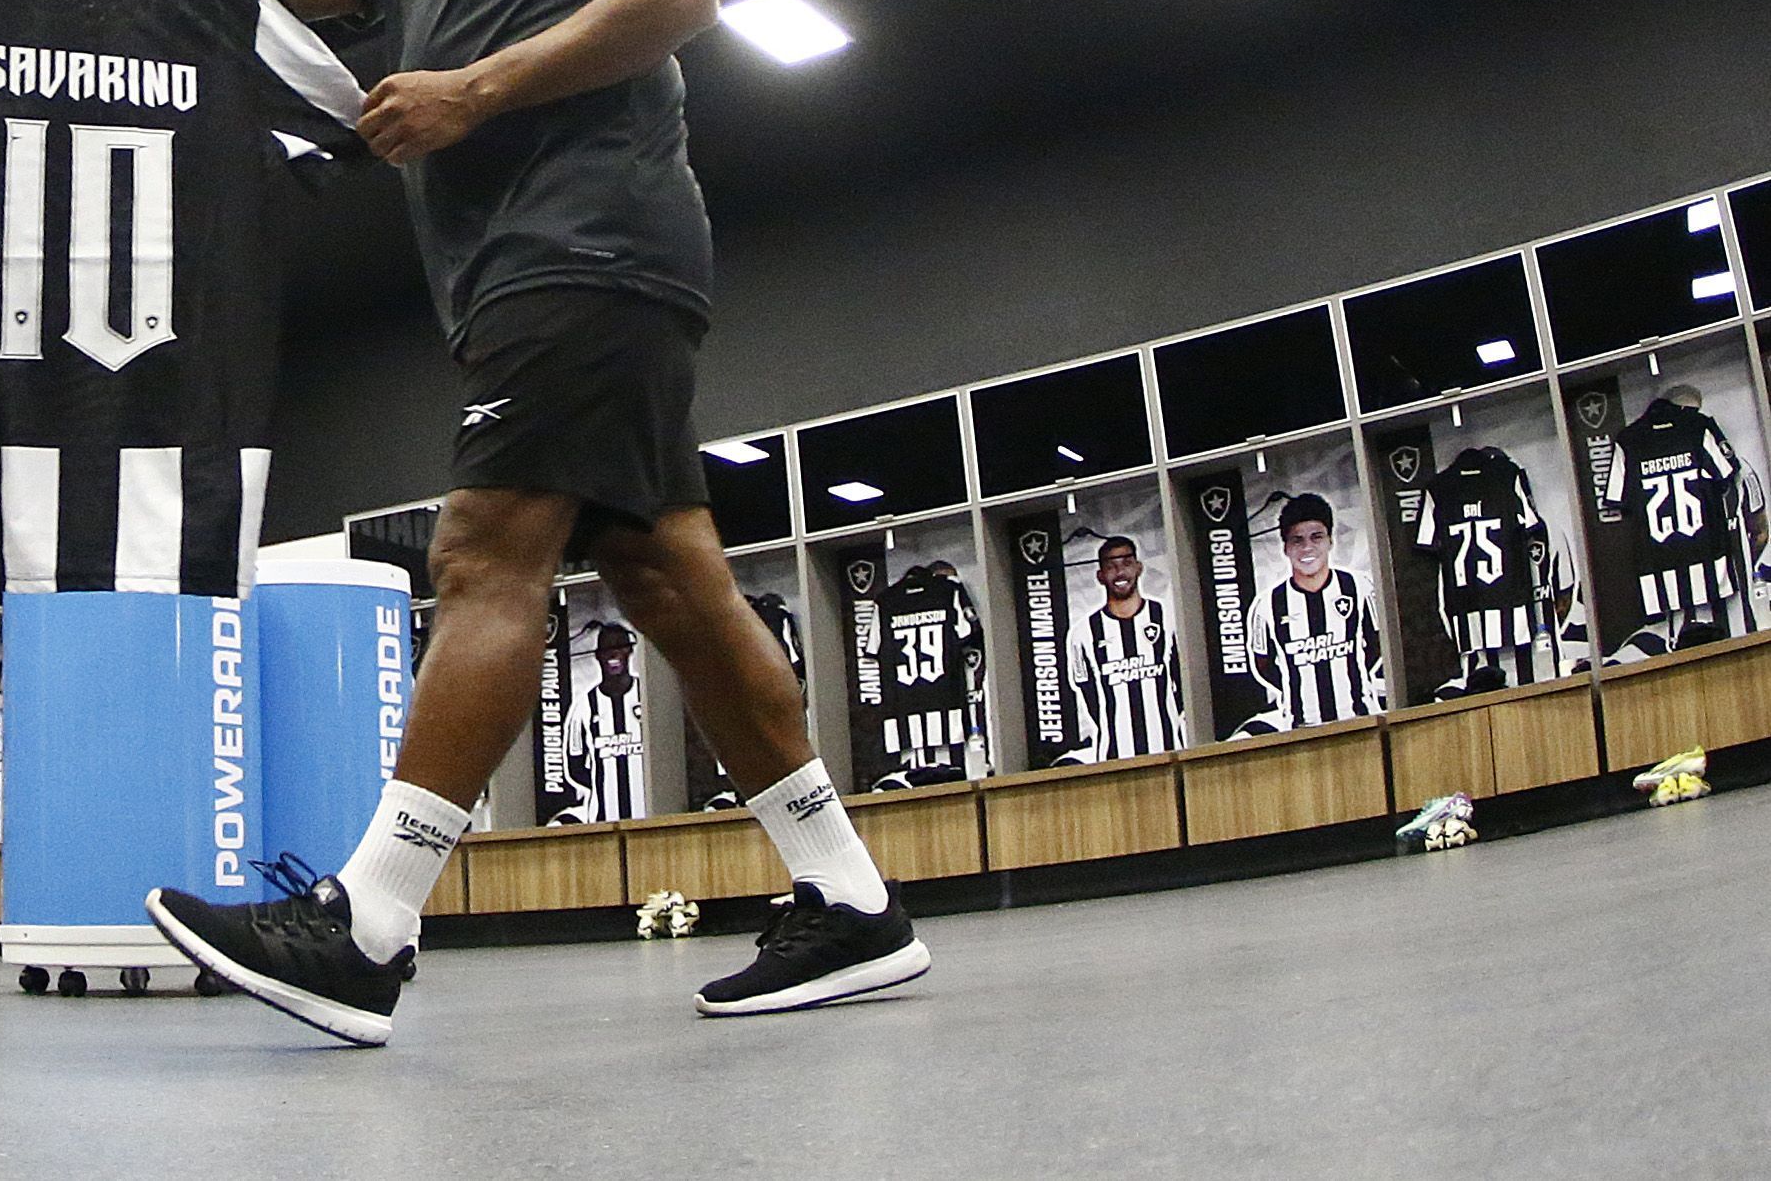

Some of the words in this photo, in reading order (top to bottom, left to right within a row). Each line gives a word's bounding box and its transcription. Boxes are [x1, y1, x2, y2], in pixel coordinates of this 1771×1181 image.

[1640, 452, 1692, 476] GREGORE
[1641, 468, 1704, 544] 26
[1209, 528, 1237, 581] URSO
[1448, 518, 1504, 587] 75
[1027, 569, 1055, 640] MACIEL
[1215, 583, 1248, 674] EMERSON
[893, 624, 945, 686] 39
[1102, 654, 1146, 676] PARI
[1284, 631, 1333, 655] PARI
[1293, 640, 1354, 667] MATCH
[375, 605, 404, 780] ERADE
[541, 648, 560, 700] PAULA
[1032, 643, 1064, 743] JEFFERSON
[1108, 663, 1164, 686] MATCH
[542, 701, 561, 723] DE
[542, 724, 564, 794] PATRICK
[599, 742, 644, 758] MATC
